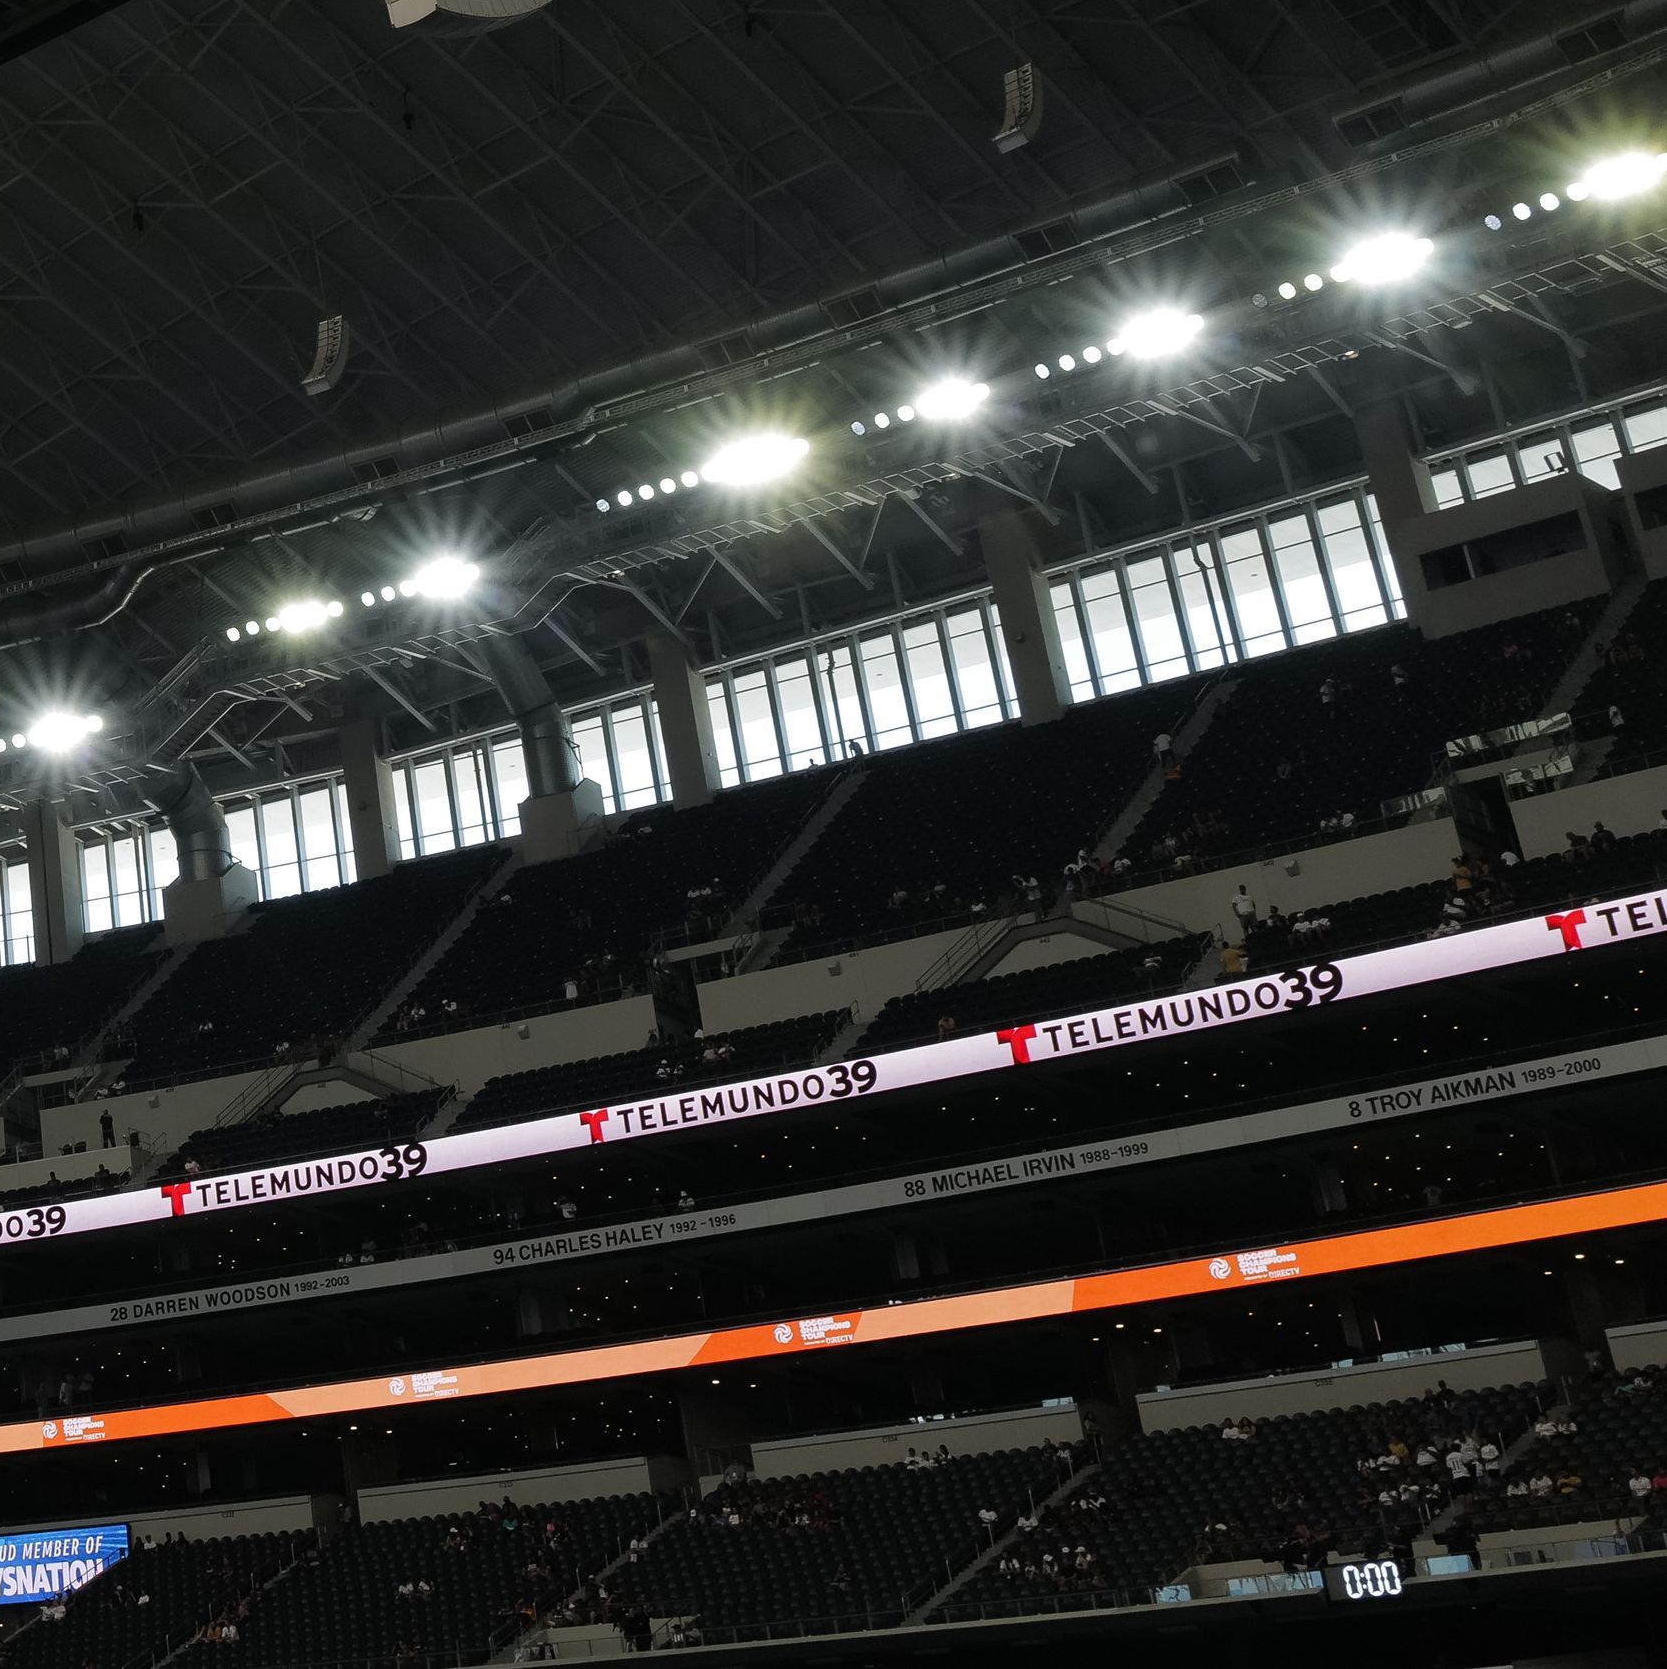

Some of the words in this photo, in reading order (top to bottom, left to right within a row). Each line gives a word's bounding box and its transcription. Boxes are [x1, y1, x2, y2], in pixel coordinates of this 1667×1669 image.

[1348, 1101, 1362, 1118] 8
[1365, 1088, 1423, 1115] TROY
[1430, 1071, 1517, 1104] AIKMAN
[1521, 1058, 1601, 1083] 1989-2000
[904, 1180, 926, 1197] 88
[931, 1164, 1019, 1193] MICHAEL
[1022, 1153, 1075, 1177] IRVIN
[1079, 1142, 1149, 1164] 1988-1999
[493, 1248, 515, 1265] 94
[519, 1233, 602, 1260] CHARLES
[605, 1223, 664, 1247] HALEY
[110, 1307, 128, 1322] 28
[133, 1295, 199, 1319] DARREN
[205, 1282, 290, 1308] WOODSON
[294, 1275, 350, 1293] 1992-2003
[22, 1539, 73, 1560] MEMBER
[85, 1536, 103, 1554] OF
[1342, 1561, 1402, 1600] 0:00
